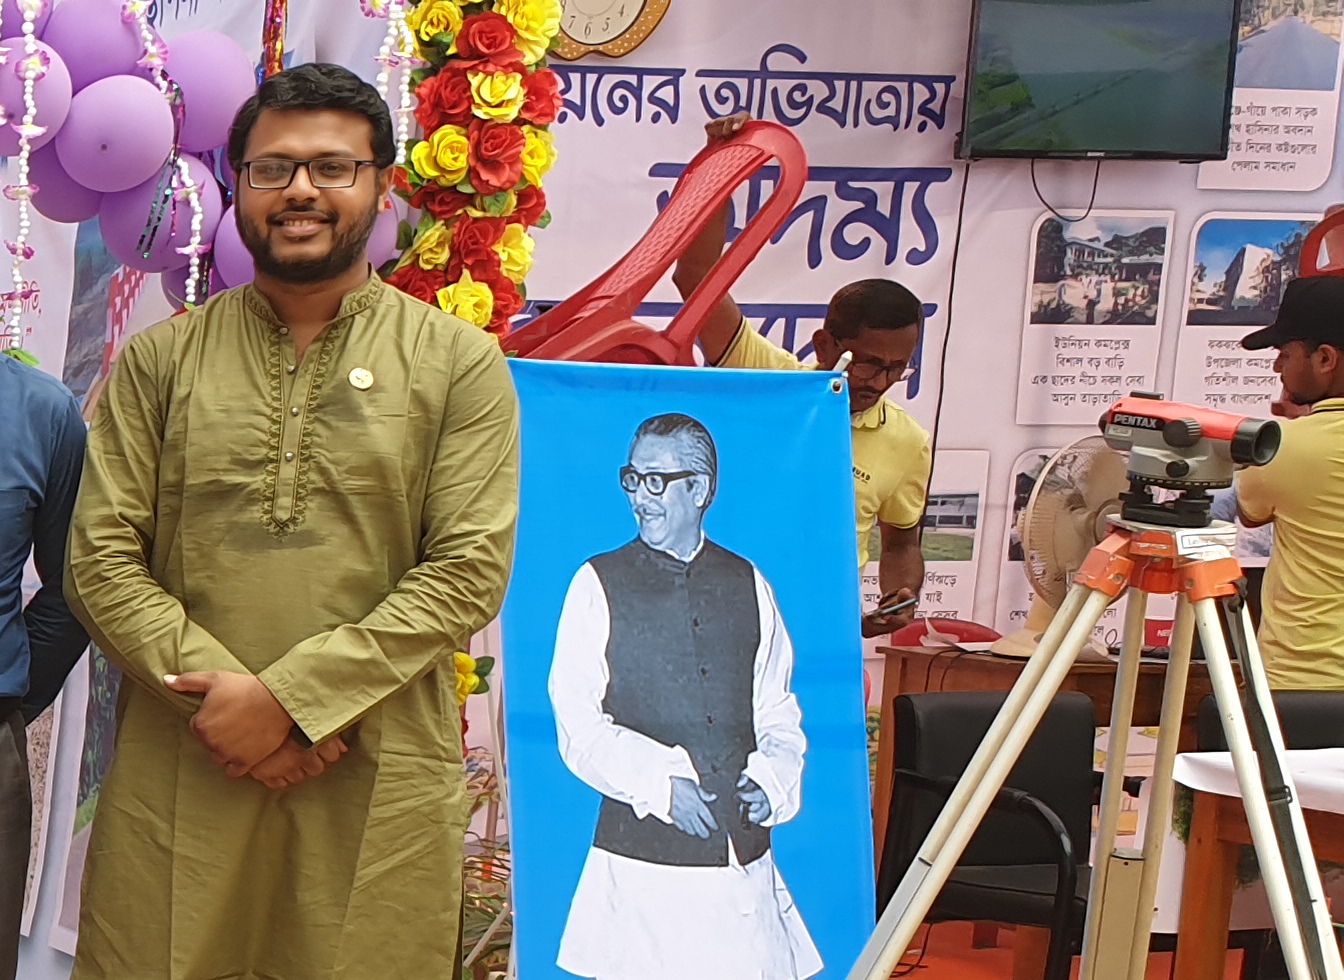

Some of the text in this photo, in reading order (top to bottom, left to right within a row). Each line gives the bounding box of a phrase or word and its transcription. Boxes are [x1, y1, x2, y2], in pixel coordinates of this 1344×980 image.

[584, 21, 592, 38] 6
[549, 43, 956, 133] য়নের অভিযাত্রায়
[1245, 357, 1275, 371] কমপ্লে
[1114, 414, 1157, 429] PENTAX
